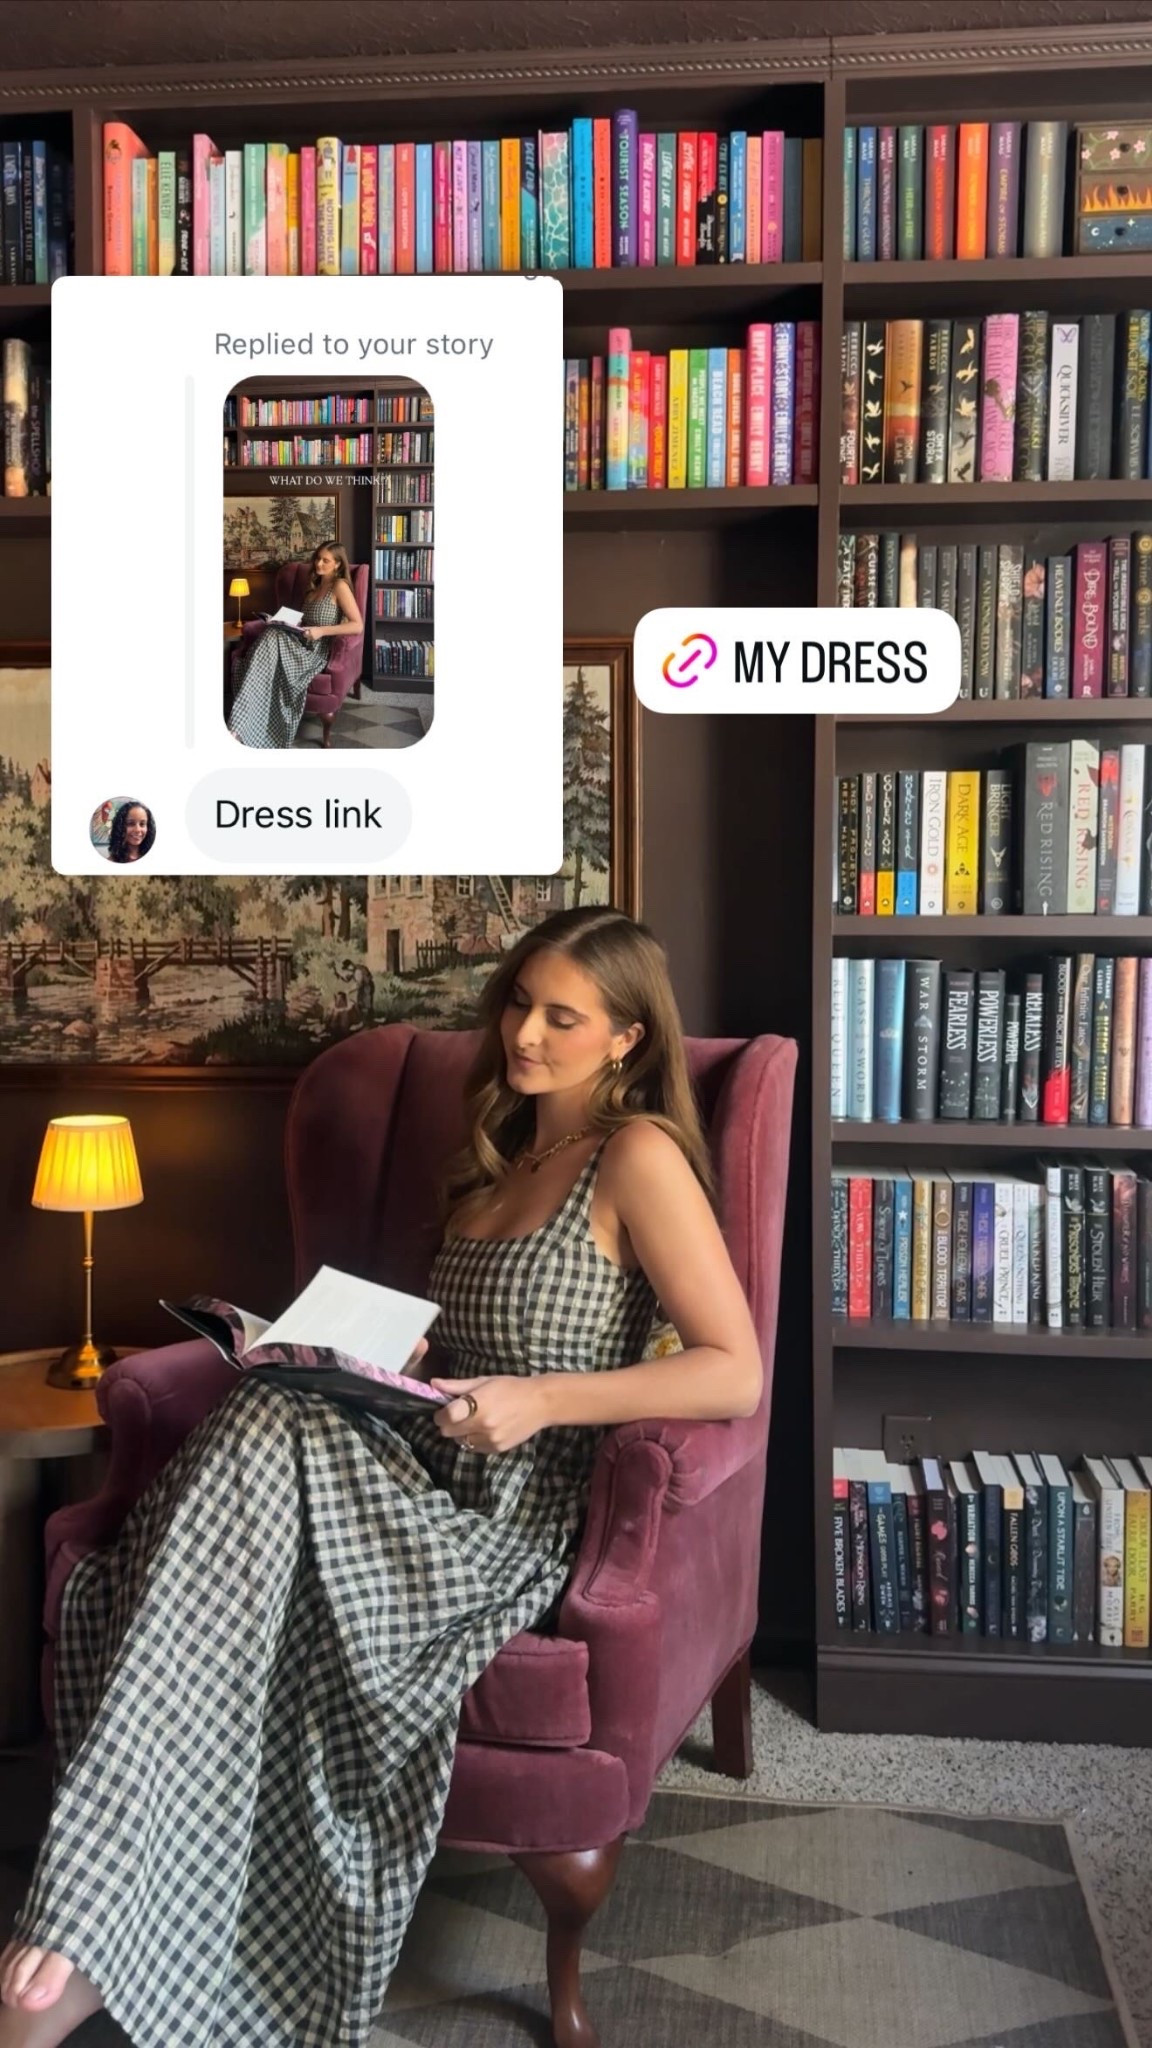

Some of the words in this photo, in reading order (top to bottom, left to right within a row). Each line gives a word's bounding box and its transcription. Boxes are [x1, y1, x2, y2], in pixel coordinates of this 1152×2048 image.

[160, 161, 172, 180] ELLE
[524, 142, 535, 169] DEEP
[619, 134, 629, 180] TOURIST
[661, 151, 673, 179] LEATHER
[160, 182, 172, 219] KENNEDY
[661, 189, 673, 208] LARK
[862, 177, 872, 215] THRONE
[882, 168, 893, 202] CROWN
[905, 187, 915, 209] HEIR
[999, 169, 1008, 201] EMPIRE
[1040, 173, 1049, 218] KINGDOM
[317, 203, 325, 223] THE
[326, 199, 335, 243] NOTHING
[619, 185, 629, 229] SEASON
[317, 225, 325, 263] MOVIES
[862, 228, 872, 256] GLASS
[882, 214, 893, 260] MIDNIGHT
[905, 221, 915, 239] FIRE
[999, 216, 1008, 255] STORMS
[1040, 229, 1049, 248] ASH
[326, 245, 335, 266] LIKE
[751, 330, 766, 363] HAPPY
[987, 322, 1002, 340] THE
[775, 332, 790, 367] FUNNY
[850, 331, 858, 376] REBECCA
[929, 333, 938, 371] YARROS
[939, 329, 949, 374] REBECCA
[633, 372, 643, 396] ABBY
[712, 371, 723, 404] BEACH
[751, 364, 766, 397] PLACE
[775, 368, 790, 400] STORY
[1126, 374, 1140, 399] SOIL
[1138, 369, 1150, 400] BONES
[31, 405, 40, 419] the
[672, 396, 680, 421] ABBY
[712, 408, 723, 434] READ
[751, 405, 766, 437] EMILY
[1057, 364, 1073, 445] QUICKSILVER
[693, 428, 703, 452] EMILY
[775, 411, 790, 440] EMILY
[1031, 416, 1042, 449] KERRI
[31, 420, 40, 476] SPELLSHOP
[672, 425, 680, 470] JIMENEZ
[751, 439, 766, 473] HENRY
[775, 442, 790, 474] HENRY
[846, 429, 856, 468] FOURTH
[894, 429, 905, 465] FLAME
[925, 430, 936, 465] STORM
[935, 432, 945, 461] ONYX
[693, 455, 703, 481] HENRY
[868, 541, 876, 549] A
[843, 560, 852, 586] FATE
[868, 552, 876, 587] CURSE
[1011, 563, 1022, 598] SHIELD
[1120, 559, 1128, 571] THE
[940, 579, 950, 587] A
[981, 579, 993, 594] AN
[1053, 564, 1065, 613] HEAVENLY
[1082, 569, 1101, 600] DIRE
[981, 597, 993, 650] HONORED
[1053, 616, 1065, 653] BODIES
[1082, 602, 1101, 649] BOUND
[981, 652, 993, 678] VOW
[865, 775, 873, 801] RED
[882, 775, 892, 825] GOLDEN
[904, 775, 914, 825] MORNING
[926, 778, 942, 813] IRON
[954, 783, 972, 821] DARK
[1000, 783, 1012, 820] LIGHT
[1074, 783, 1092, 820] RED
[987, 783, 1002, 838] BRINGER
[1036, 801, 1054, 835] RED
[1100, 798, 1108, 828] BRANDON
[865, 806, 873, 856] RISING
[882, 829, 892, 855] SON
[904, 828, 914, 860] STAR
[926, 816, 942, 857] GOLD
[954, 826, 972, 853] AGE
[1074, 828, 1092, 890] RISING
[1100, 830, 1108, 866] SANDERSON
[1036, 838, 1054, 897] RISING
[1055, 963, 1066, 994] BLOOD
[1078, 963, 1093, 984] Our
[1103, 964, 1112, 999] STEPHANIE
[856, 976, 867, 1025] GLASS
[917, 976, 931, 1011] WAR
[1078, 986, 1093, 1018] Infinite
[946, 990, 969, 1050] FEARLESS
[977, 990, 1000, 1062] POWERLESS
[1024, 992, 1043, 1051] RECKLESS
[1055, 1014, 1066, 1045] BRIGHT
[1078, 1021, 1093, 1047] Fates
[1005, 1021, 1019, 1064] POWERFUL
[832, 1033, 842, 1099] QUEEN
[856, 1047, 867, 1104] SWORD
[917, 1035, 931, 1090] STORM
[856, 1212, 864, 1233] VOW
[956, 1210, 969, 1232] THESE
[976, 1211, 990, 1233] THESE
[898, 1236, 909, 1267] PRISON
[936, 1235, 948, 1266] BLOOD
[956, 1234, 969, 1273] HOLLOW
[998, 1229, 1010, 1261] CRUEL
[1030, 1230, 1042, 1271] WICKED
[1090, 1229, 1107, 1273] STOLEN
[833, 1250, 842, 1291] THIEVES
[856, 1243, 864, 1288] THIEVES
[876, 1254, 891, 1287] THORNS
[898, 1269, 909, 1303] HEALER
[936, 1269, 948, 1308] TRAITOR
[956, 1275, 969, 1303] VOWS
[998, 1266, 1010, 1302] PRINCE
[1030, 1272, 1042, 1301] KING
[1090, 1275, 1107, 1302] HEIR
[1056, 1491, 1066, 1518] UPON
[834, 1516, 846, 1537] FIVE
[877, 1514, 888, 1544] GAMES
[967, 1504, 976, 1542] VARIATION
[1009, 1512, 1019, 1543] FALLEN
[834, 1538, 846, 1576] BROKEN
[856, 1541, 866, 1579] MONSOON
[1009, 1544, 1019, 1567] GODS
[1056, 1527, 1066, 1565] STARLIT
[967, 1559, 976, 1583] REBECCA
[1056, 1569, 1066, 1591] TIDE
[1138, 1558, 1148, 1583] LAST
[834, 1578, 846, 1613] BLADES
[856, 1580, 866, 1606] RISING
[1130, 1587, 1139, 1621] PARRY
